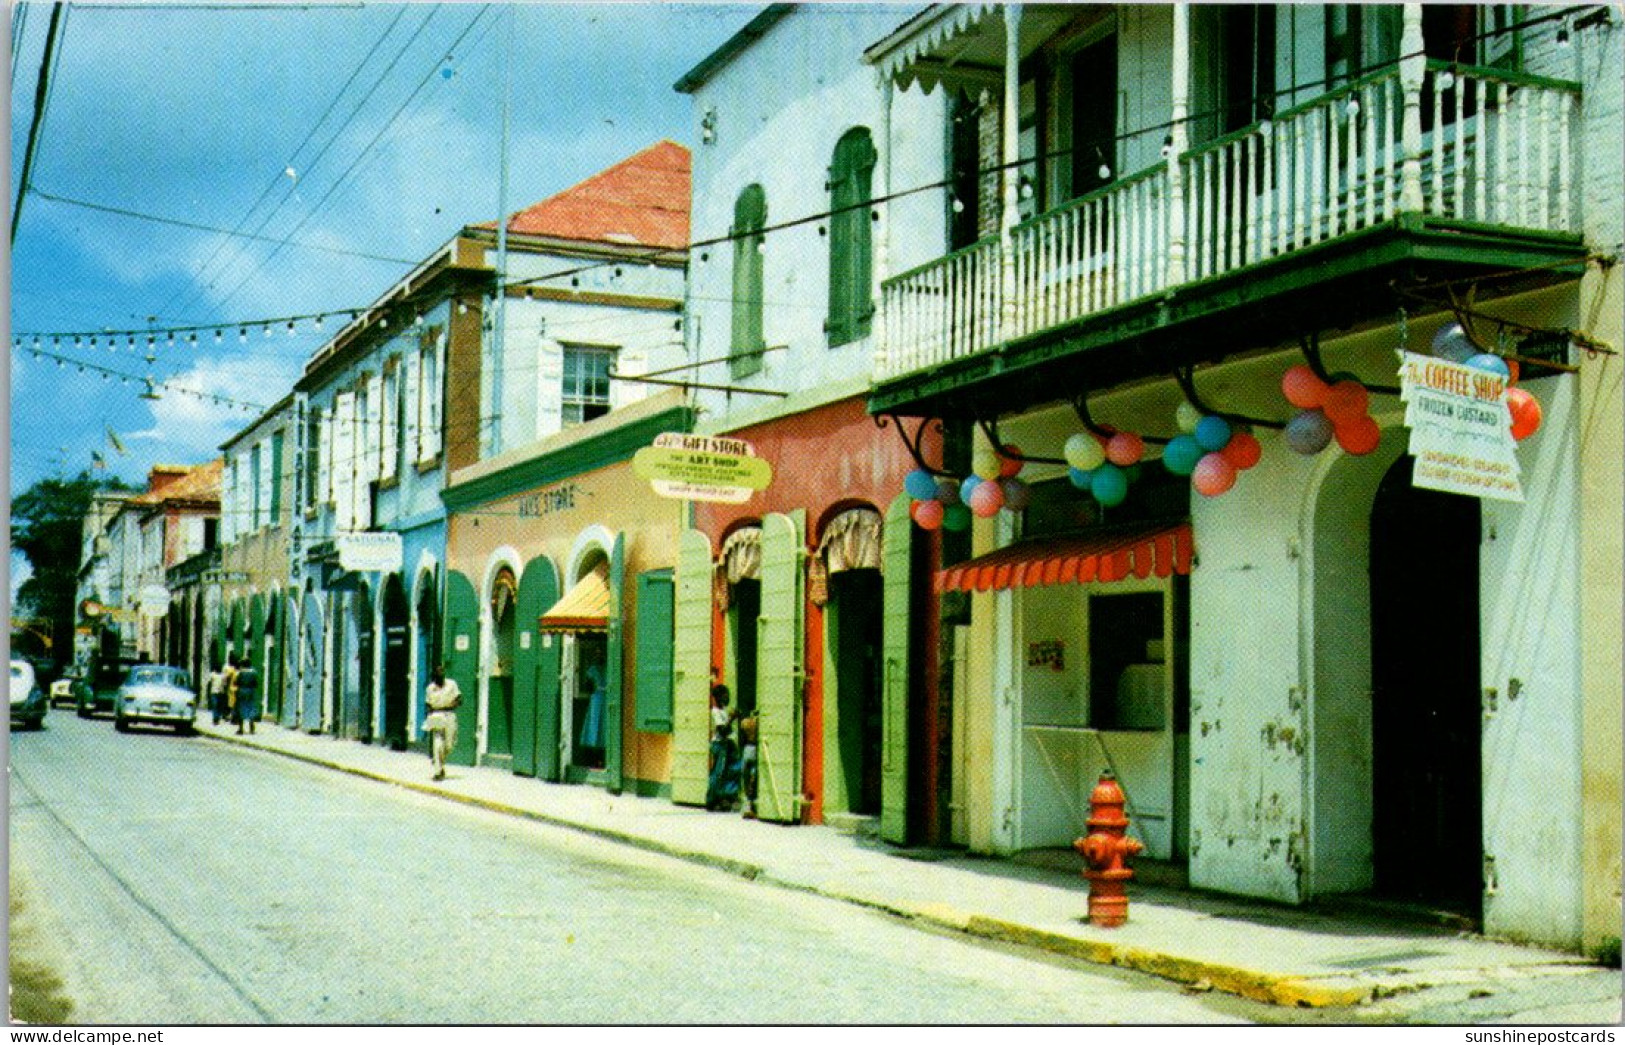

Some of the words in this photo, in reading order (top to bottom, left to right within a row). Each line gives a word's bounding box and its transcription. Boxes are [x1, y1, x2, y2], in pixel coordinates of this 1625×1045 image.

[1425, 361, 1469, 396] COFFEE
[1473, 372, 1504, 402] SHOP
[1418, 396, 1453, 418] FROZEN
[1456, 403, 1498, 427] CUSTARD
[682, 437, 709, 451] GIFT
[711, 439, 748, 456] STORE
[688, 455, 710, 464] ART
[713, 457, 740, 467] SHOP
[544, 484, 575, 515] STORE
